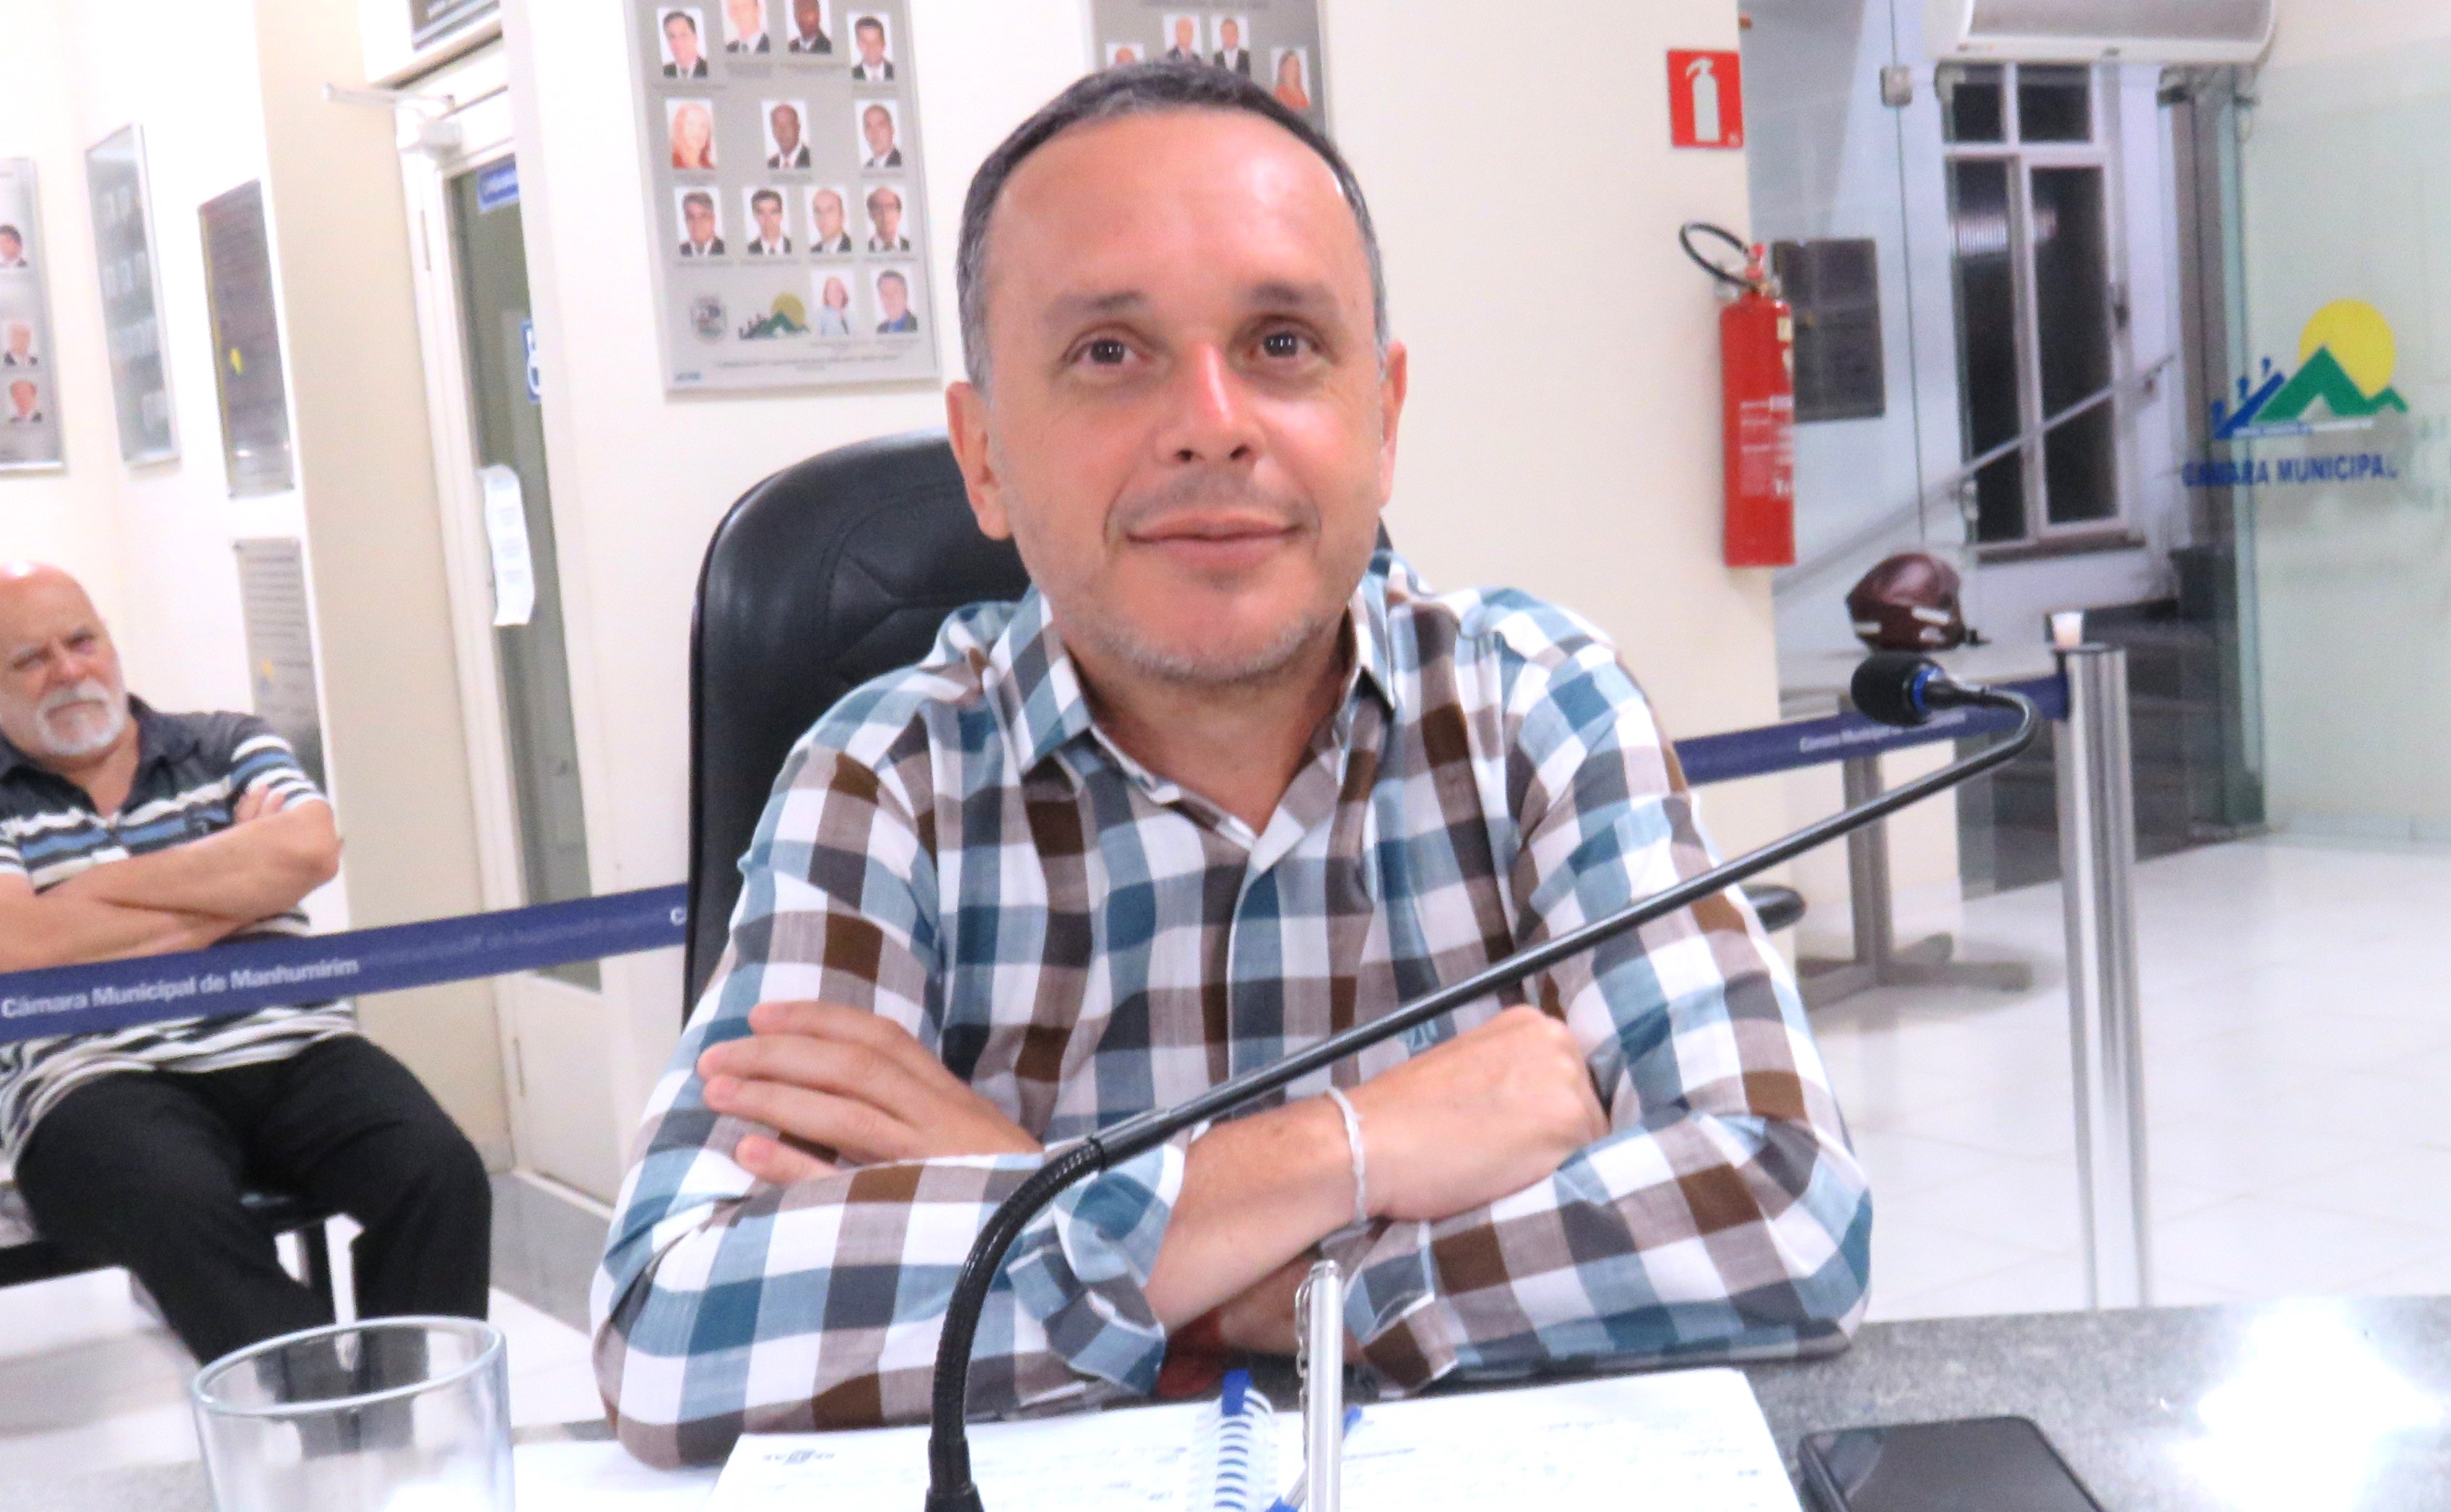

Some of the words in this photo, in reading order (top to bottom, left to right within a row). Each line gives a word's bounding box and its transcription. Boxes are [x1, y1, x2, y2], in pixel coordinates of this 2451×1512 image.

[1, 992, 88, 1018] Câmara
[91, 977, 196, 1007] Municipal
[199, 973, 227, 994] de
[230, 957, 360, 989] Manhumirim
